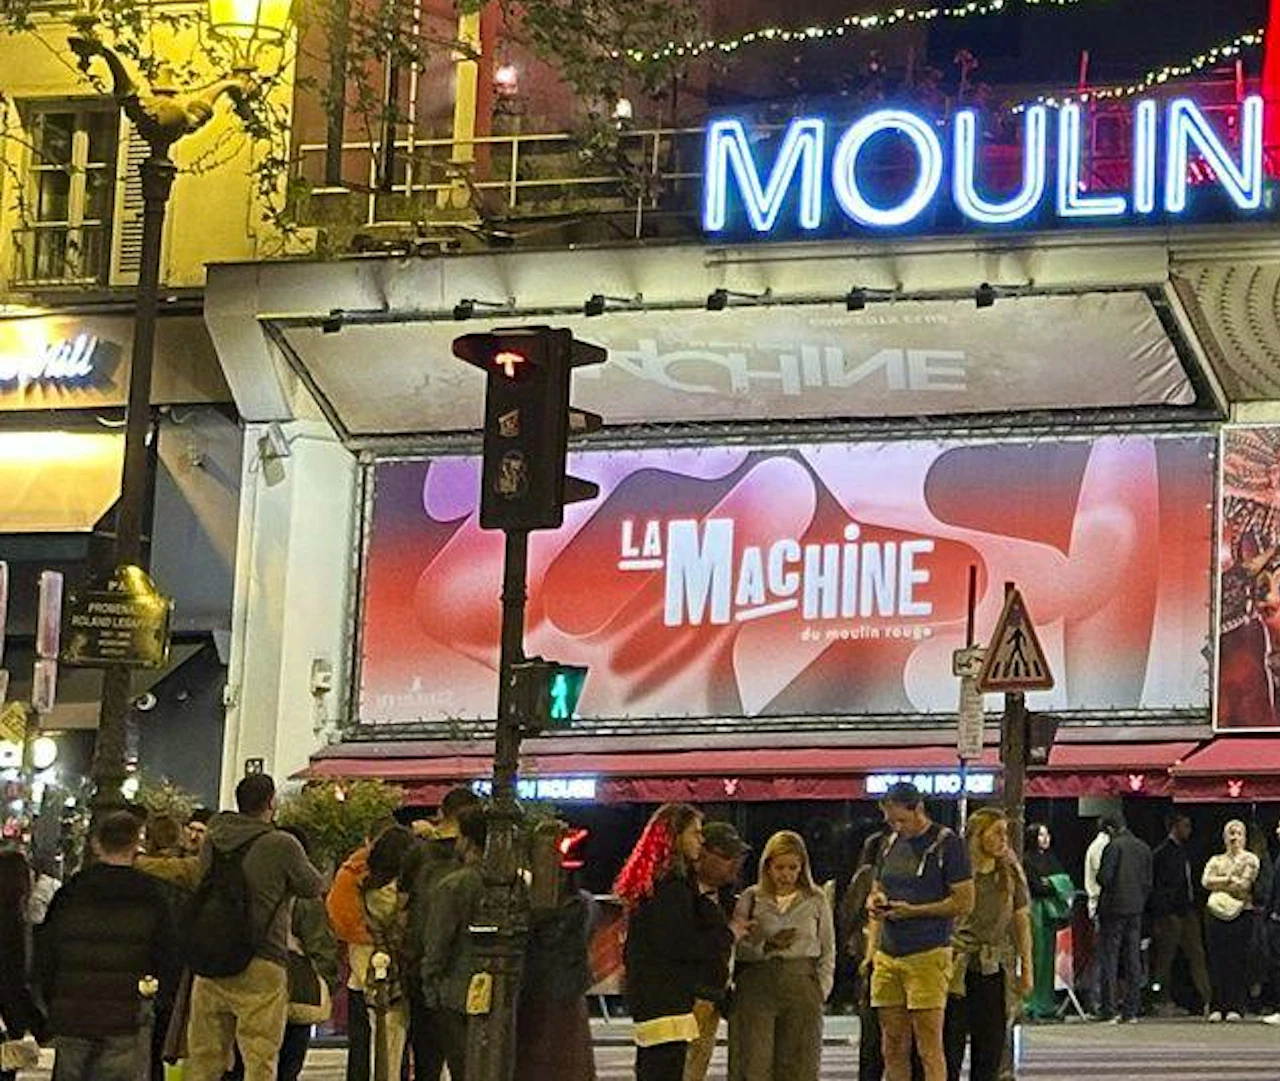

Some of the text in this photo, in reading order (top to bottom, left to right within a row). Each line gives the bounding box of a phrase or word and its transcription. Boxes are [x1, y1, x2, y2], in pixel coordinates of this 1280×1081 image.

[704, 96, 1265, 232] MOULIN
[620, 520, 662, 558] LA
[801, 625, 933, 641] du moulin rouge
